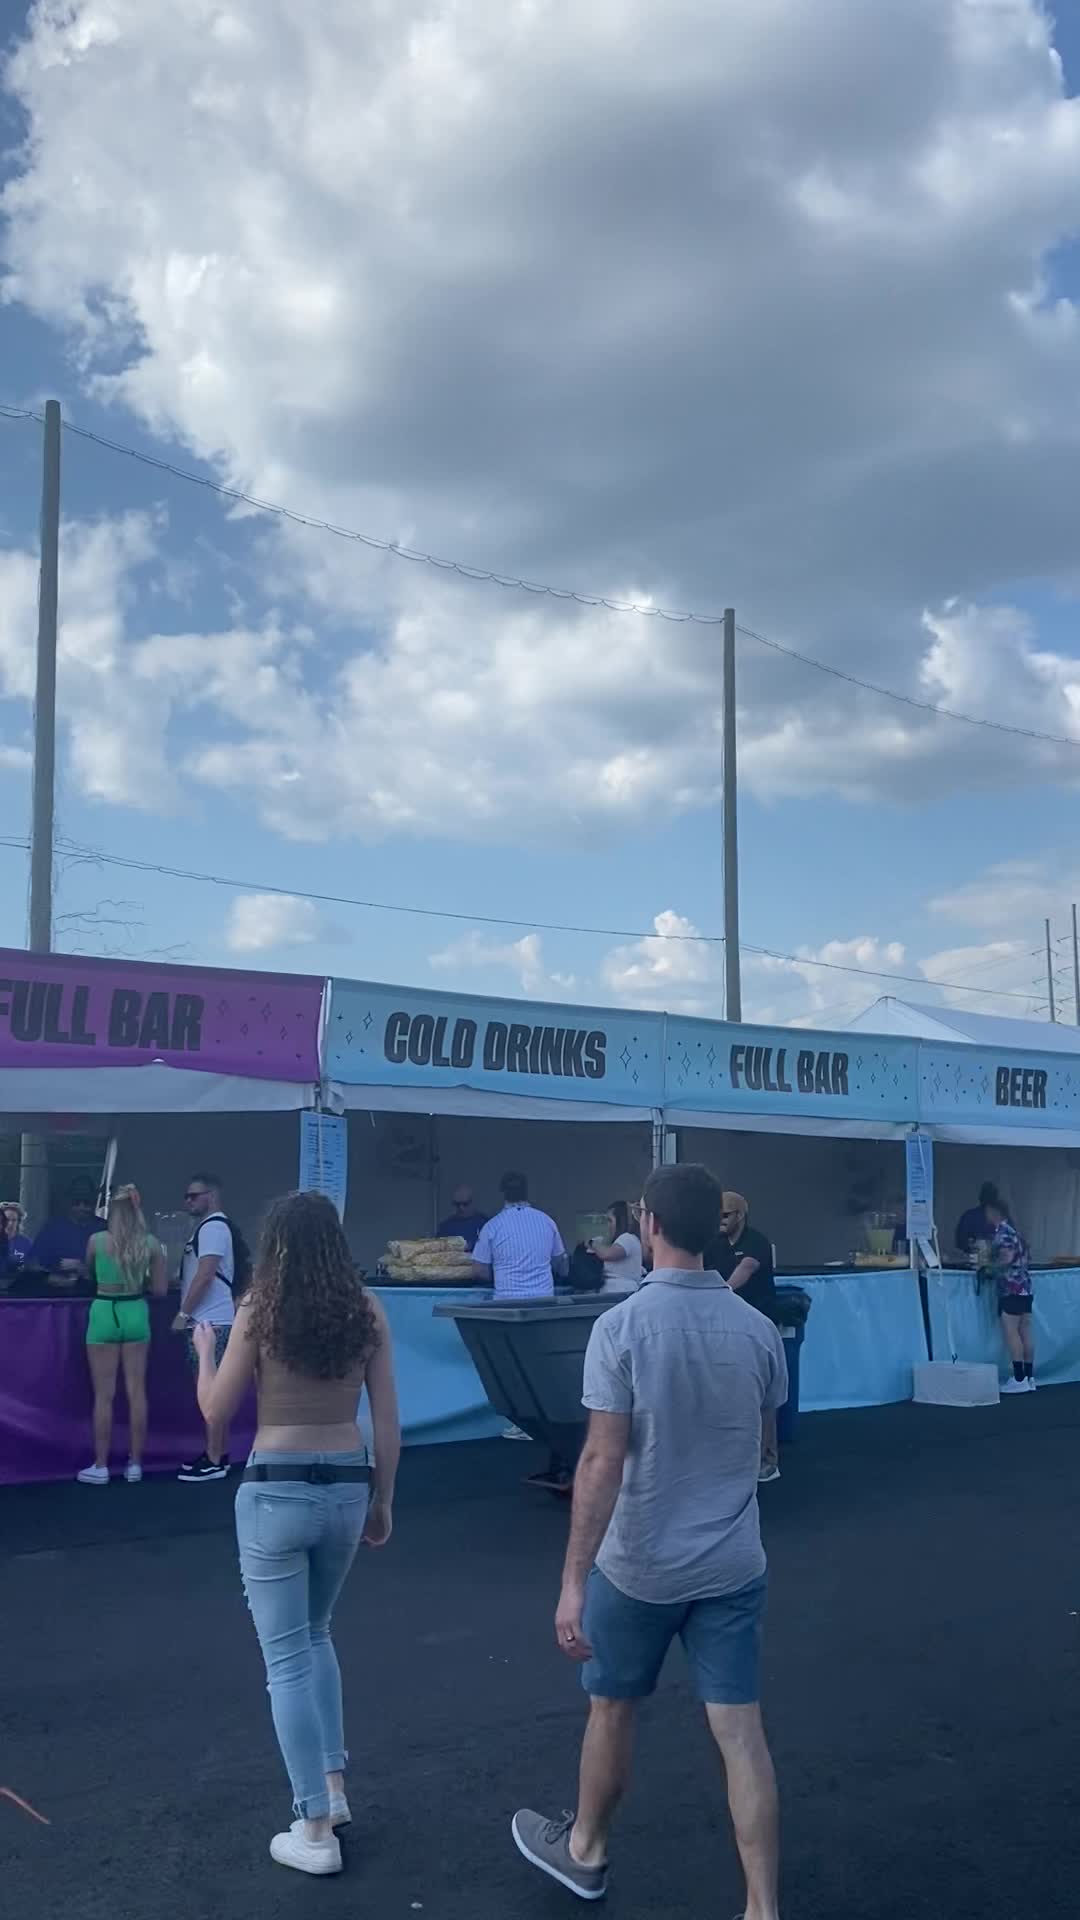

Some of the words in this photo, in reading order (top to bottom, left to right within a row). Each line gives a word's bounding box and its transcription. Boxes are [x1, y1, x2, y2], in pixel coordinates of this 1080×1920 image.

[108, 988, 205, 1051] BAR
[383, 1011, 478, 1069] COLD
[483, 1021, 608, 1079] DRINKS
[730, 1044, 792, 1093] FULL
[797, 1049, 849, 1096] BAR
[995, 1066, 1048, 1109] BEER
